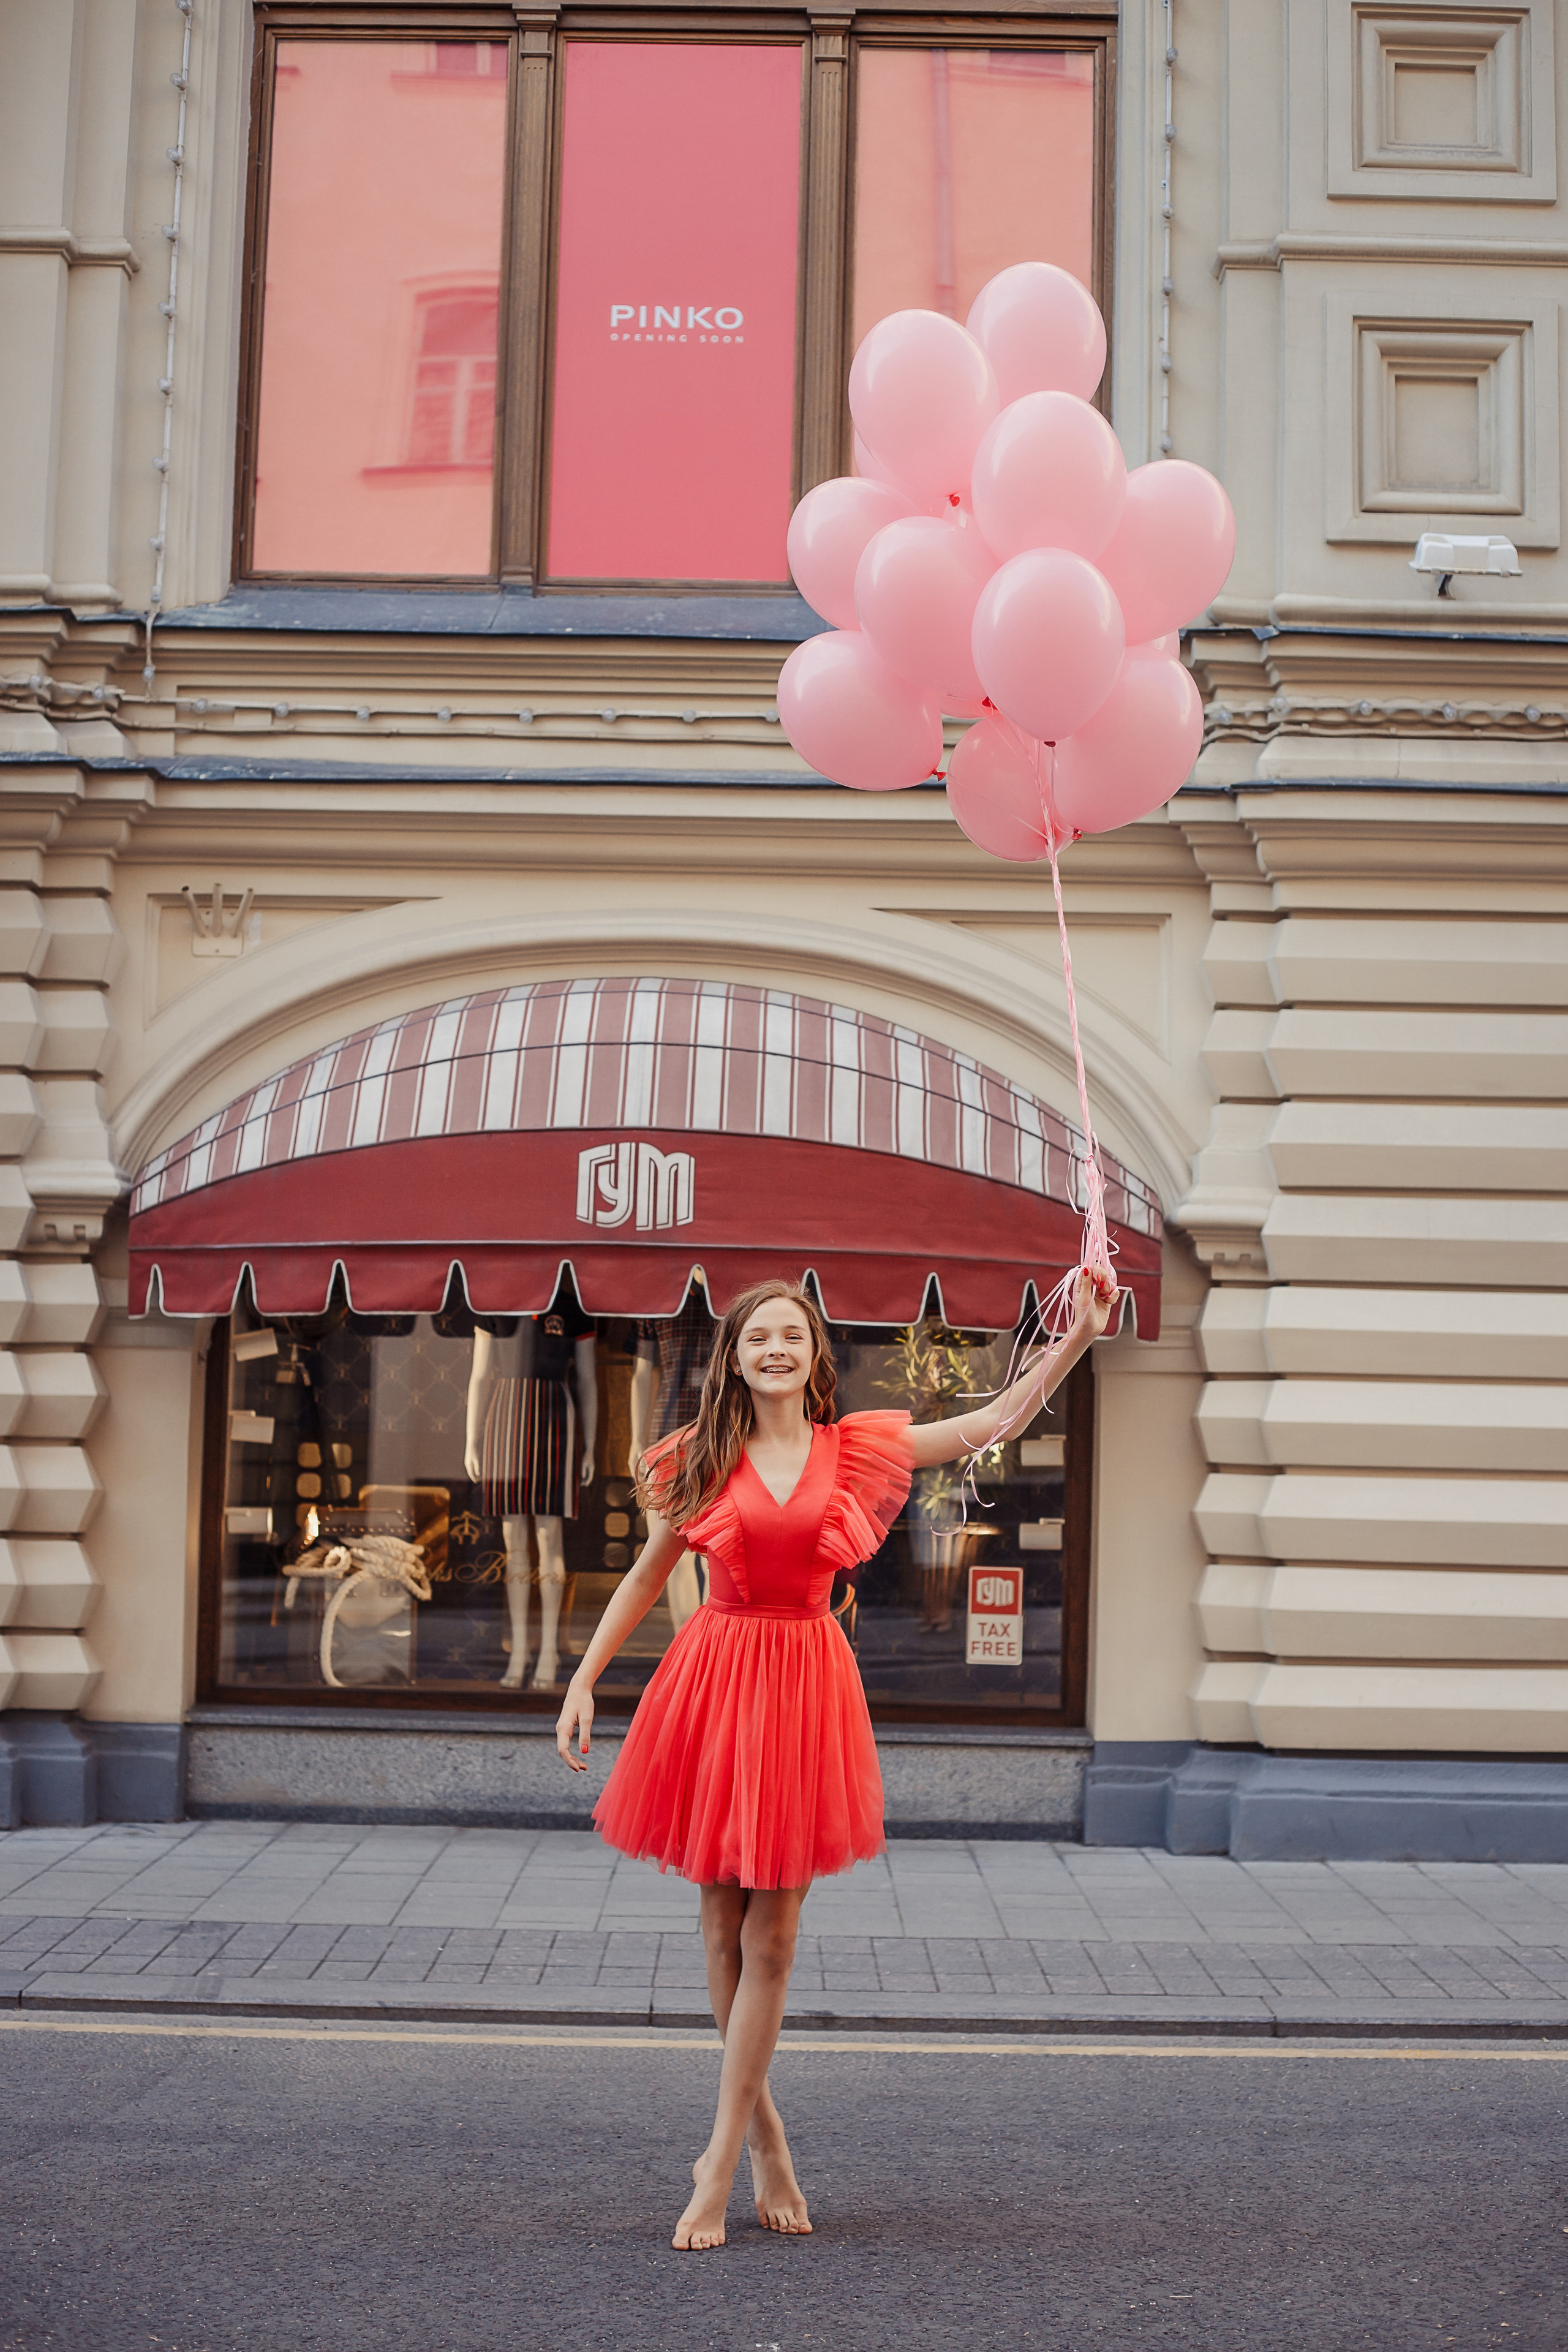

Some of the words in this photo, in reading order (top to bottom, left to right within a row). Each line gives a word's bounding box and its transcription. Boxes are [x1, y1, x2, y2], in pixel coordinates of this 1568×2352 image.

[610, 304, 744, 330] PINKO
[609, 333, 688, 343] OPENING
[699, 334, 744, 344] SOON
[978, 1623, 1011, 1637] TAX
[971, 1641, 1017, 1656] FREE
